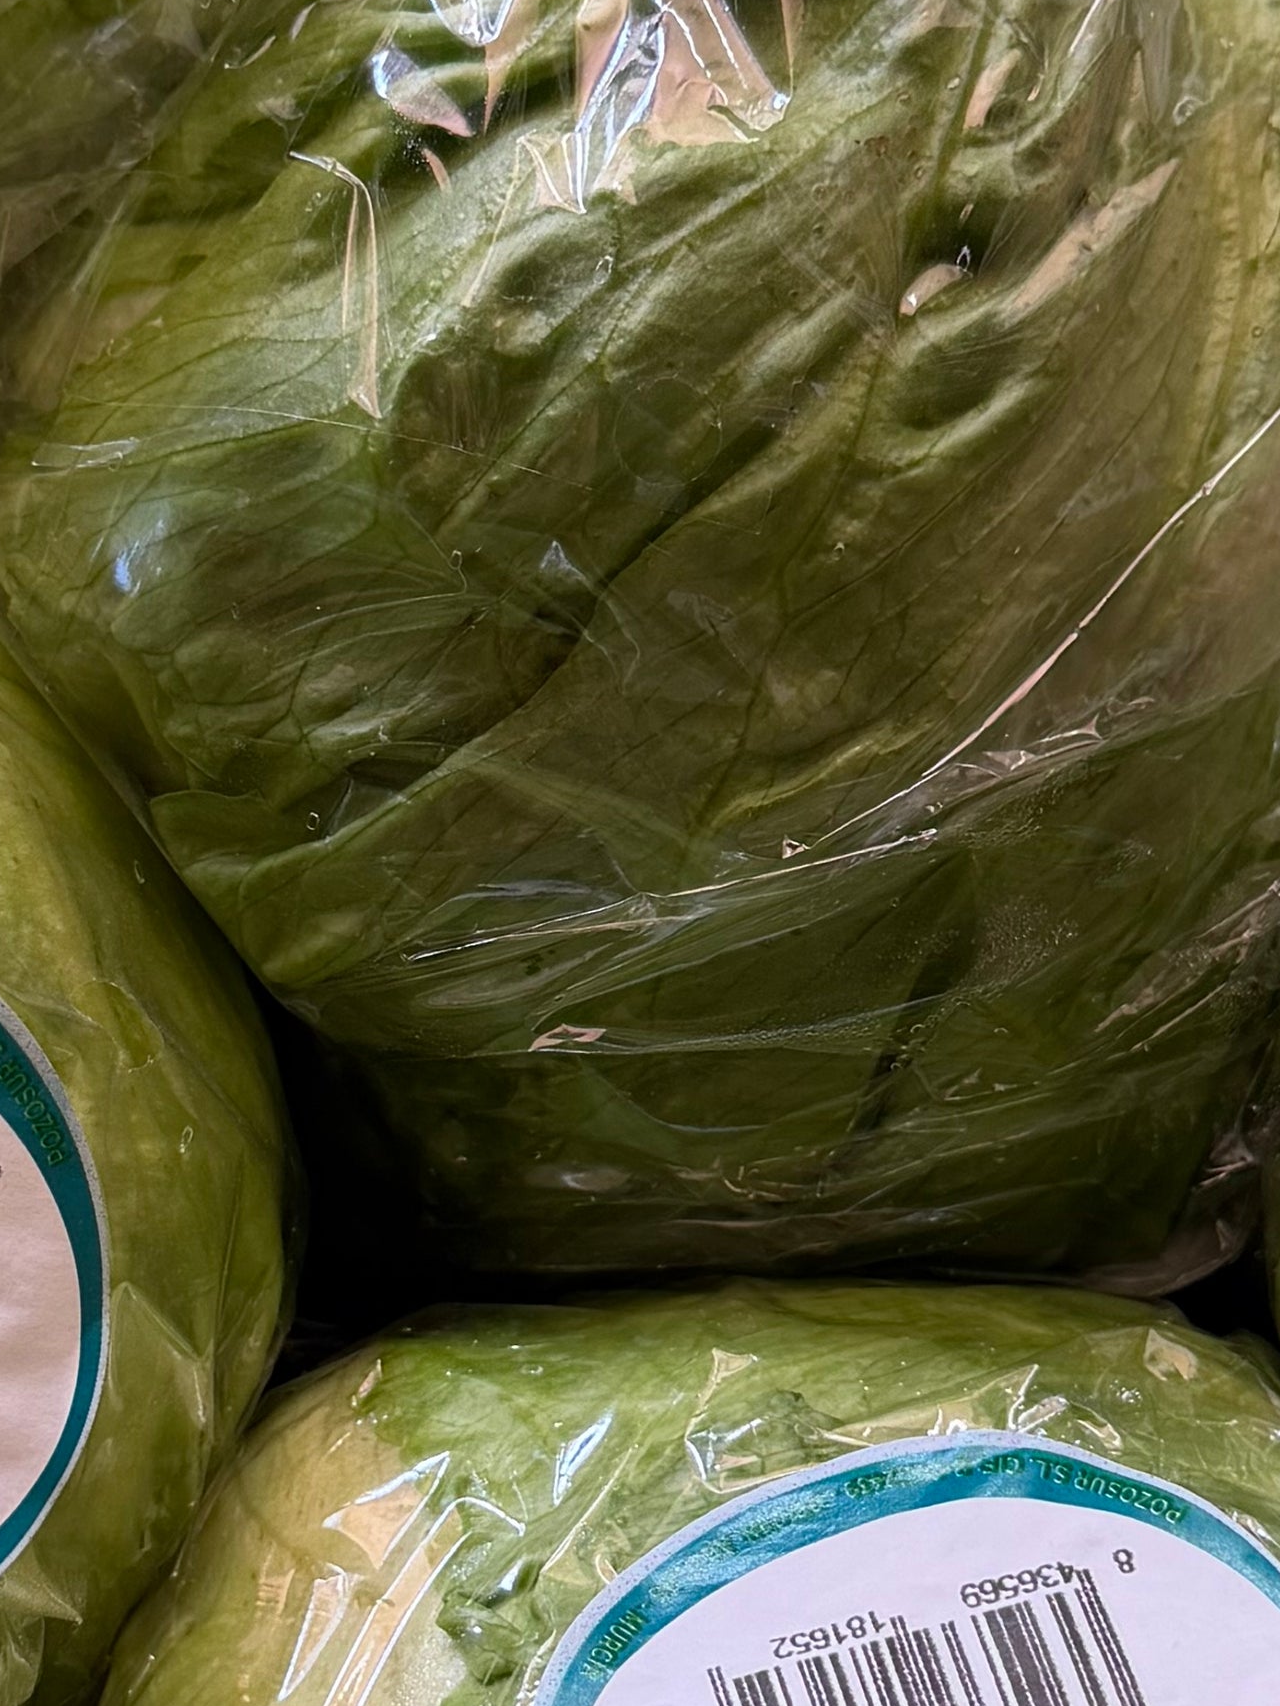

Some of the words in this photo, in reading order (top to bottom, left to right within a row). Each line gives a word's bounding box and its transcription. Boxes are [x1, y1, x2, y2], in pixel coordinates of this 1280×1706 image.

[1029, 1457, 1067, 1483] S.L.
[1071, 1470, 1181, 1524] POZOSUR
[1112, 1548, 1135, 1573] 8
[960, 1561, 1074, 1607] 436569
[579, 1609, 643, 1681] MURCIA
[769, 1611, 885, 1658] 181652
